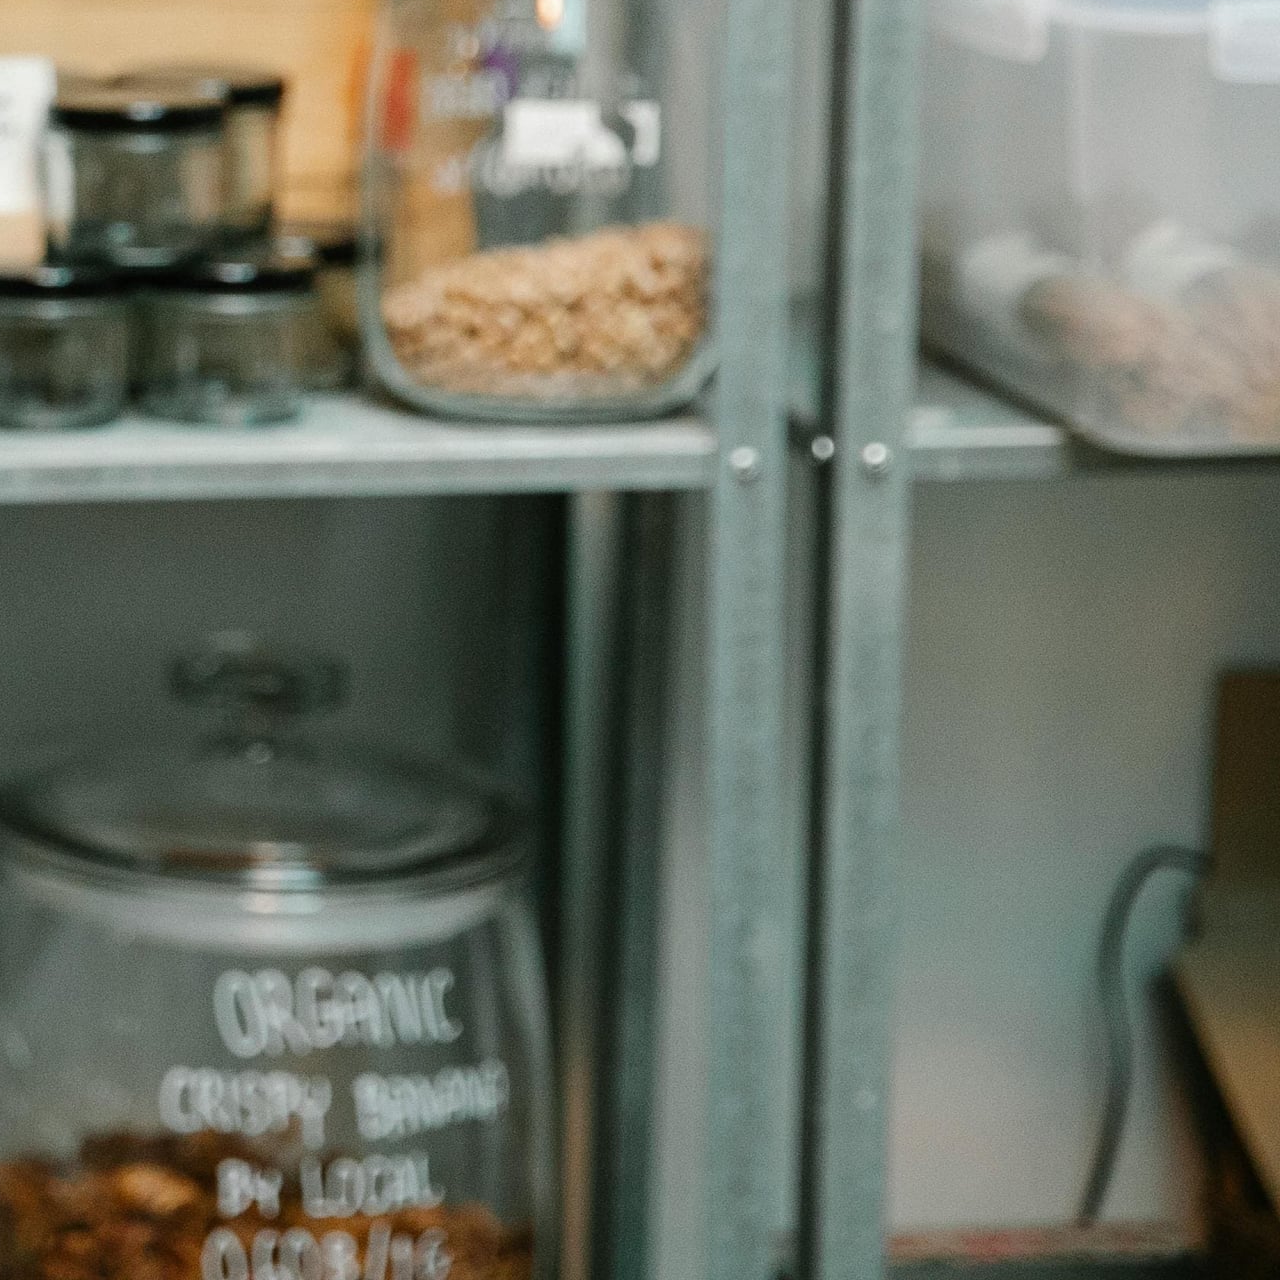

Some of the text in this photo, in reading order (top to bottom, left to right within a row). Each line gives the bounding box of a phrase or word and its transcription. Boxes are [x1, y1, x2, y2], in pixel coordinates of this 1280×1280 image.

[213, 966, 463, 1058] ORGANIC
[159, 1063, 332, 1150] CRISPY
[300, 1150, 445, 1220] LOCAL
